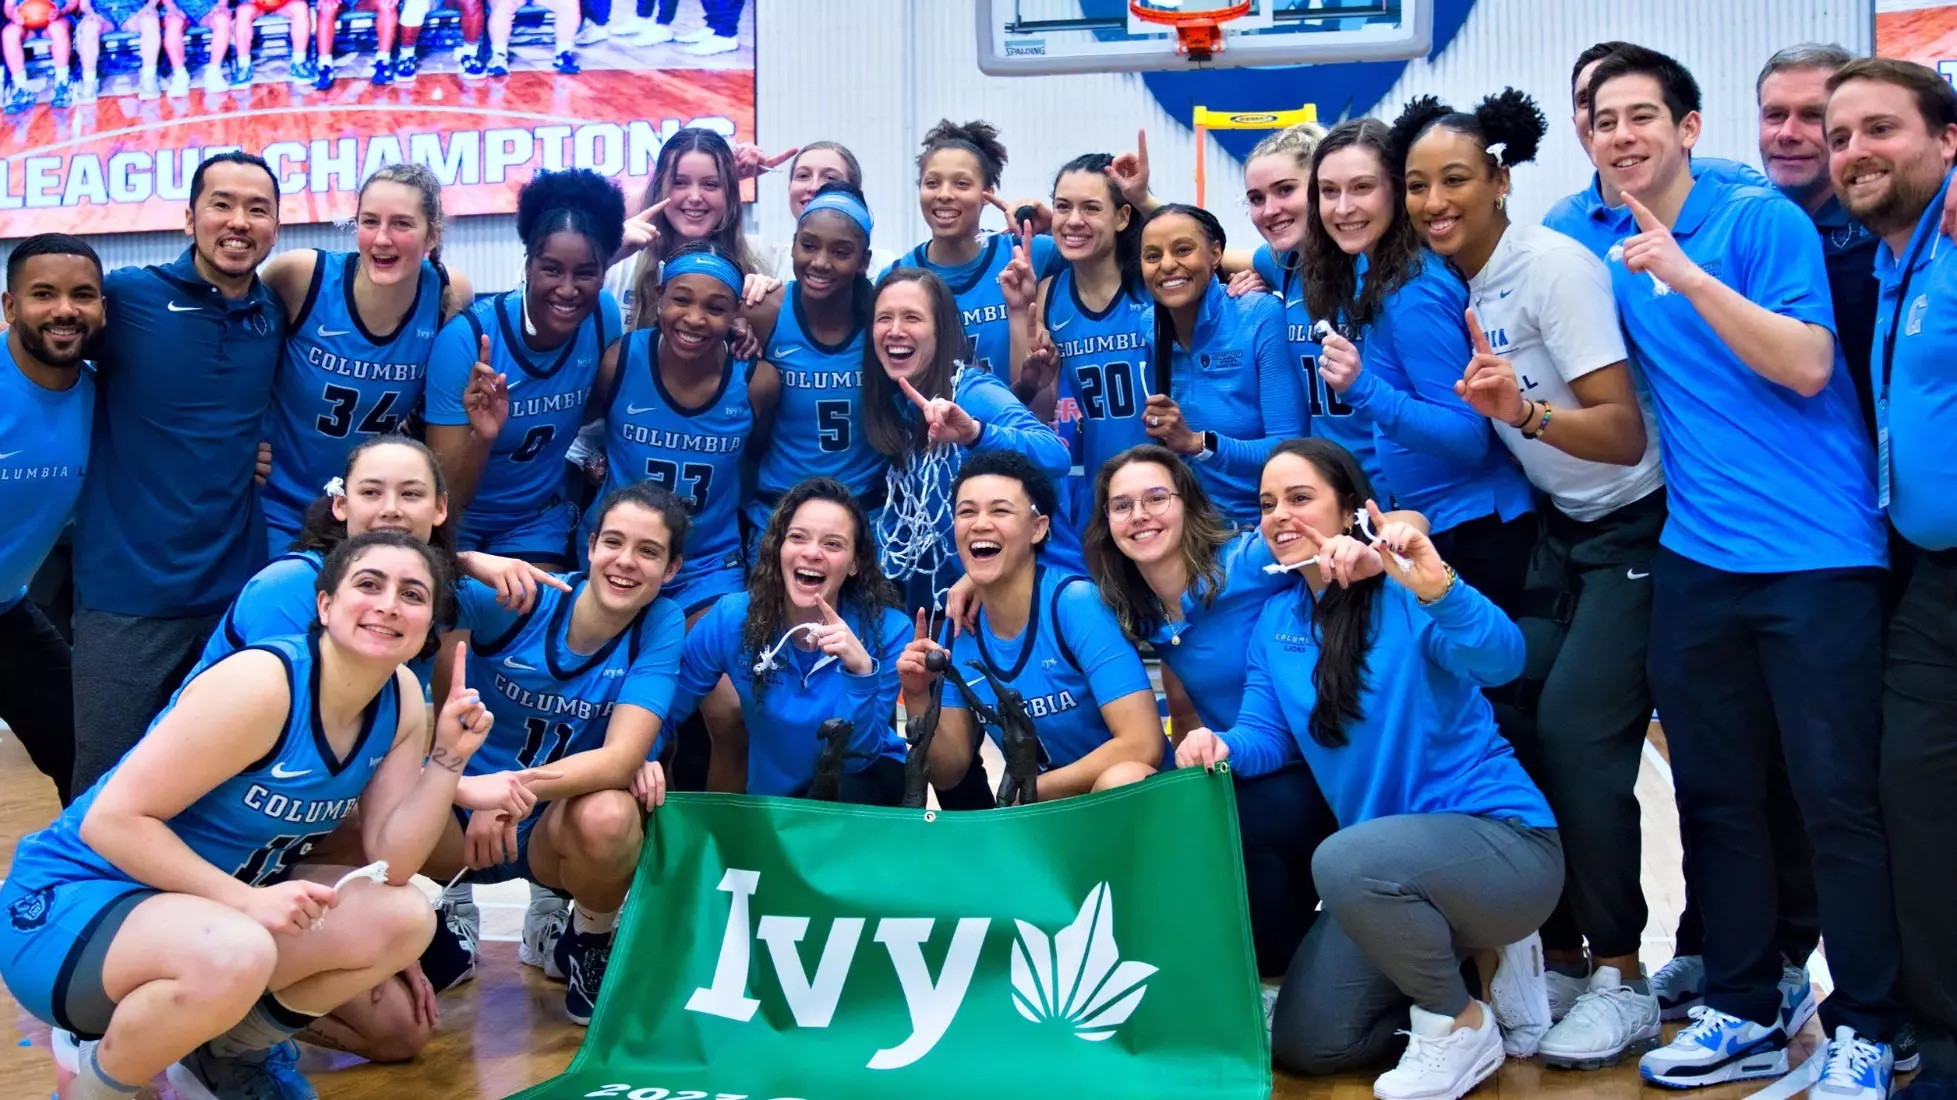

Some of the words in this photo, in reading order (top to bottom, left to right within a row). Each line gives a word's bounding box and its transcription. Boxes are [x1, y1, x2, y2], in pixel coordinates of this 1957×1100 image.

[1005, 46, 1046, 57] SPALDING
[0, 144, 242, 210] LEAGU
[1905, 292, 1927, 336] C
[315, 382, 401, 439] 34
[1075, 360, 1136, 420] 20
[622, 423, 741, 453] COLUMBIA
[815, 399, 852, 453] 5
[432, 746, 464, 773] 22
[684, 868, 992, 1070] Ivy
